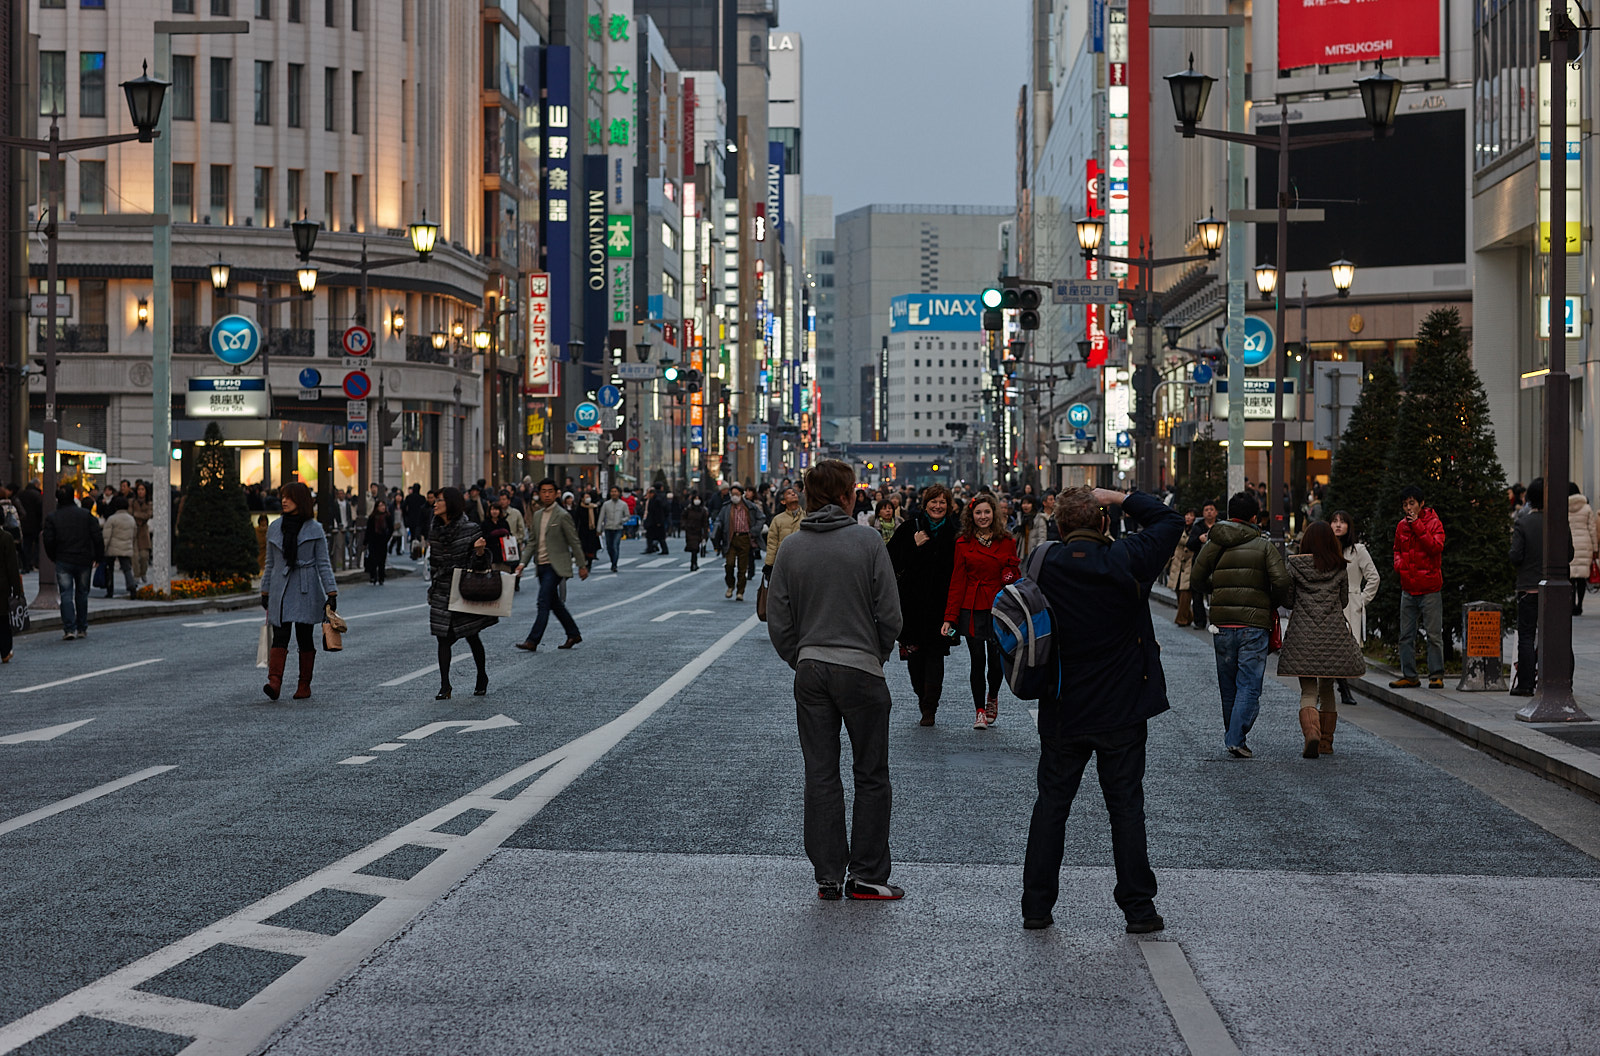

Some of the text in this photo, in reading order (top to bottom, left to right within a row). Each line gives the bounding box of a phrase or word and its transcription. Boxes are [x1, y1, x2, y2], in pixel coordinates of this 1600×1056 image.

[1325, 39, 1393, 56] MITSUKOSHI
[608, 13, 629, 146] 教文館
[1256, 109, 1303, 123] Panasnic
[548, 105, 568, 222] 山野楽器
[768, 164, 780, 228] MIZUHO
[588, 190, 605, 291] MIKIMOTO
[608, 221, 630, 251] 本
[613, 265, 624, 323] ナルニア国
[929, 299, 977, 316] INAX
[1057, 286, 1114, 296] 銀座四丁目
[533, 302, 546, 378] キムラヤのパン
[209, 394, 245, 405] 銀座駅
